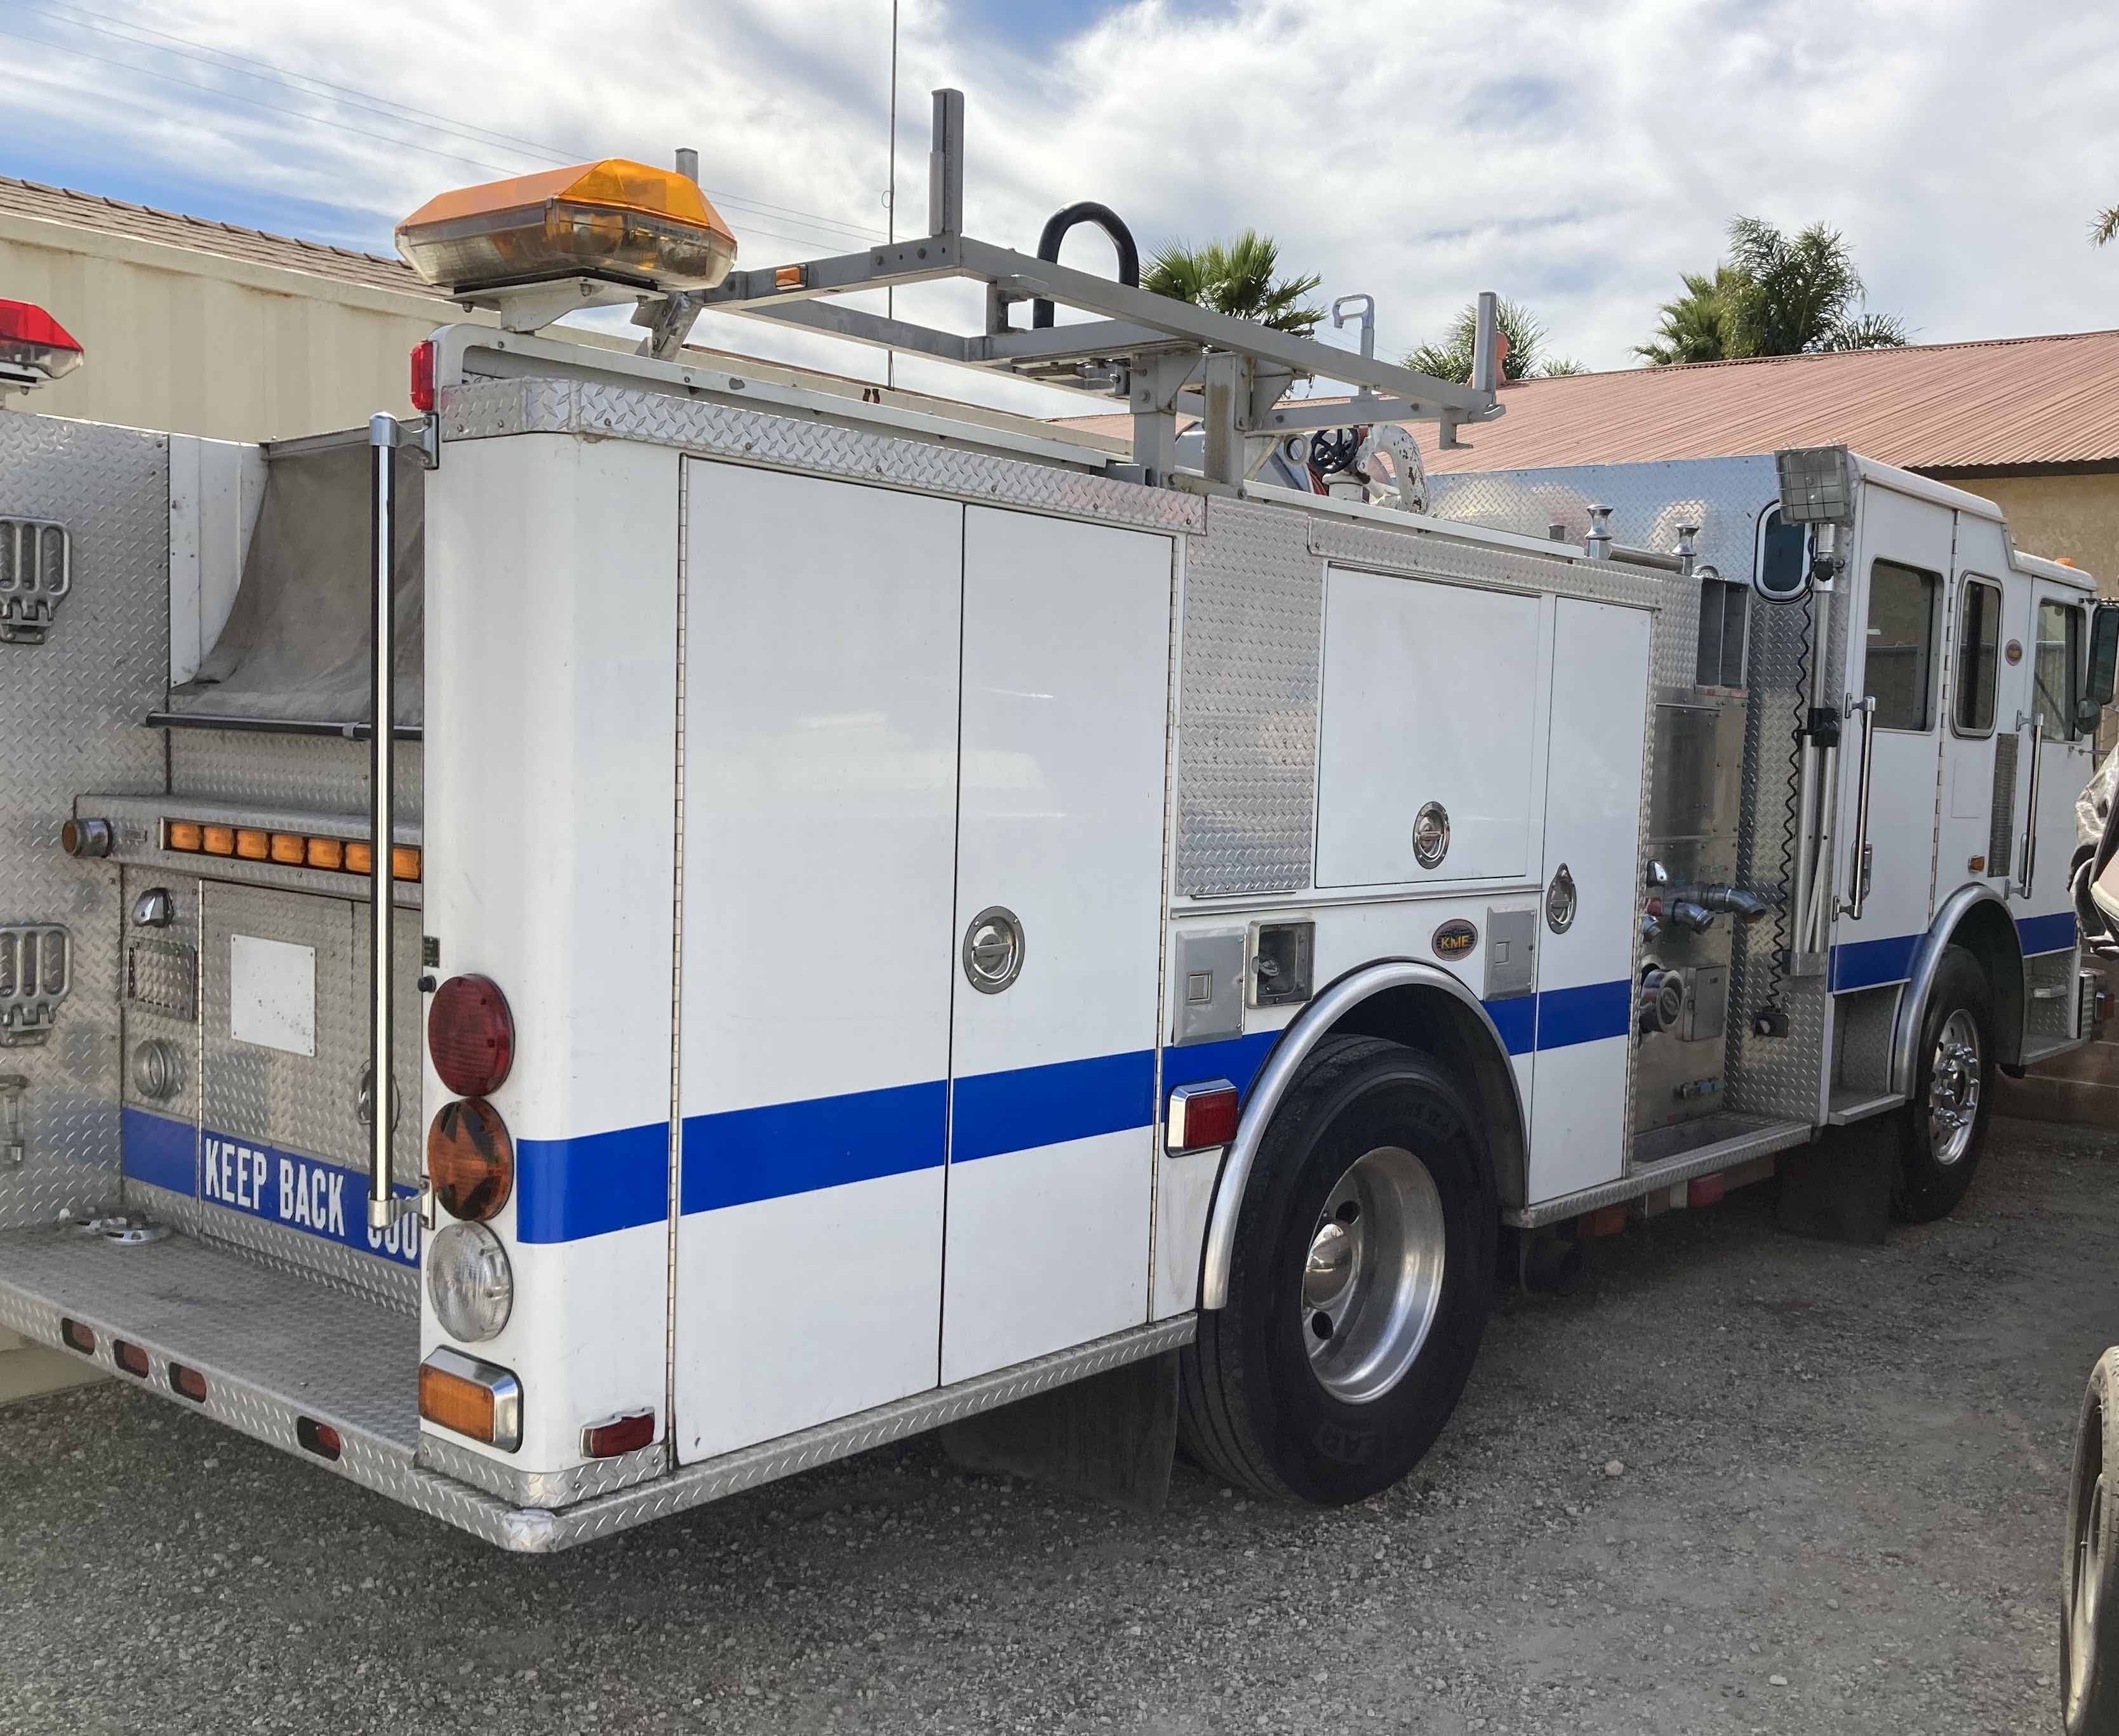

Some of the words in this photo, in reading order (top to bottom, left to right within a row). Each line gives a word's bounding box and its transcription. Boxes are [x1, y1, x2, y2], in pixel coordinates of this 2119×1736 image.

[1441, 935, 1470, 949] KME
[205, 1137, 267, 1210] KEEP
[279, 1158, 345, 1237] BACK
